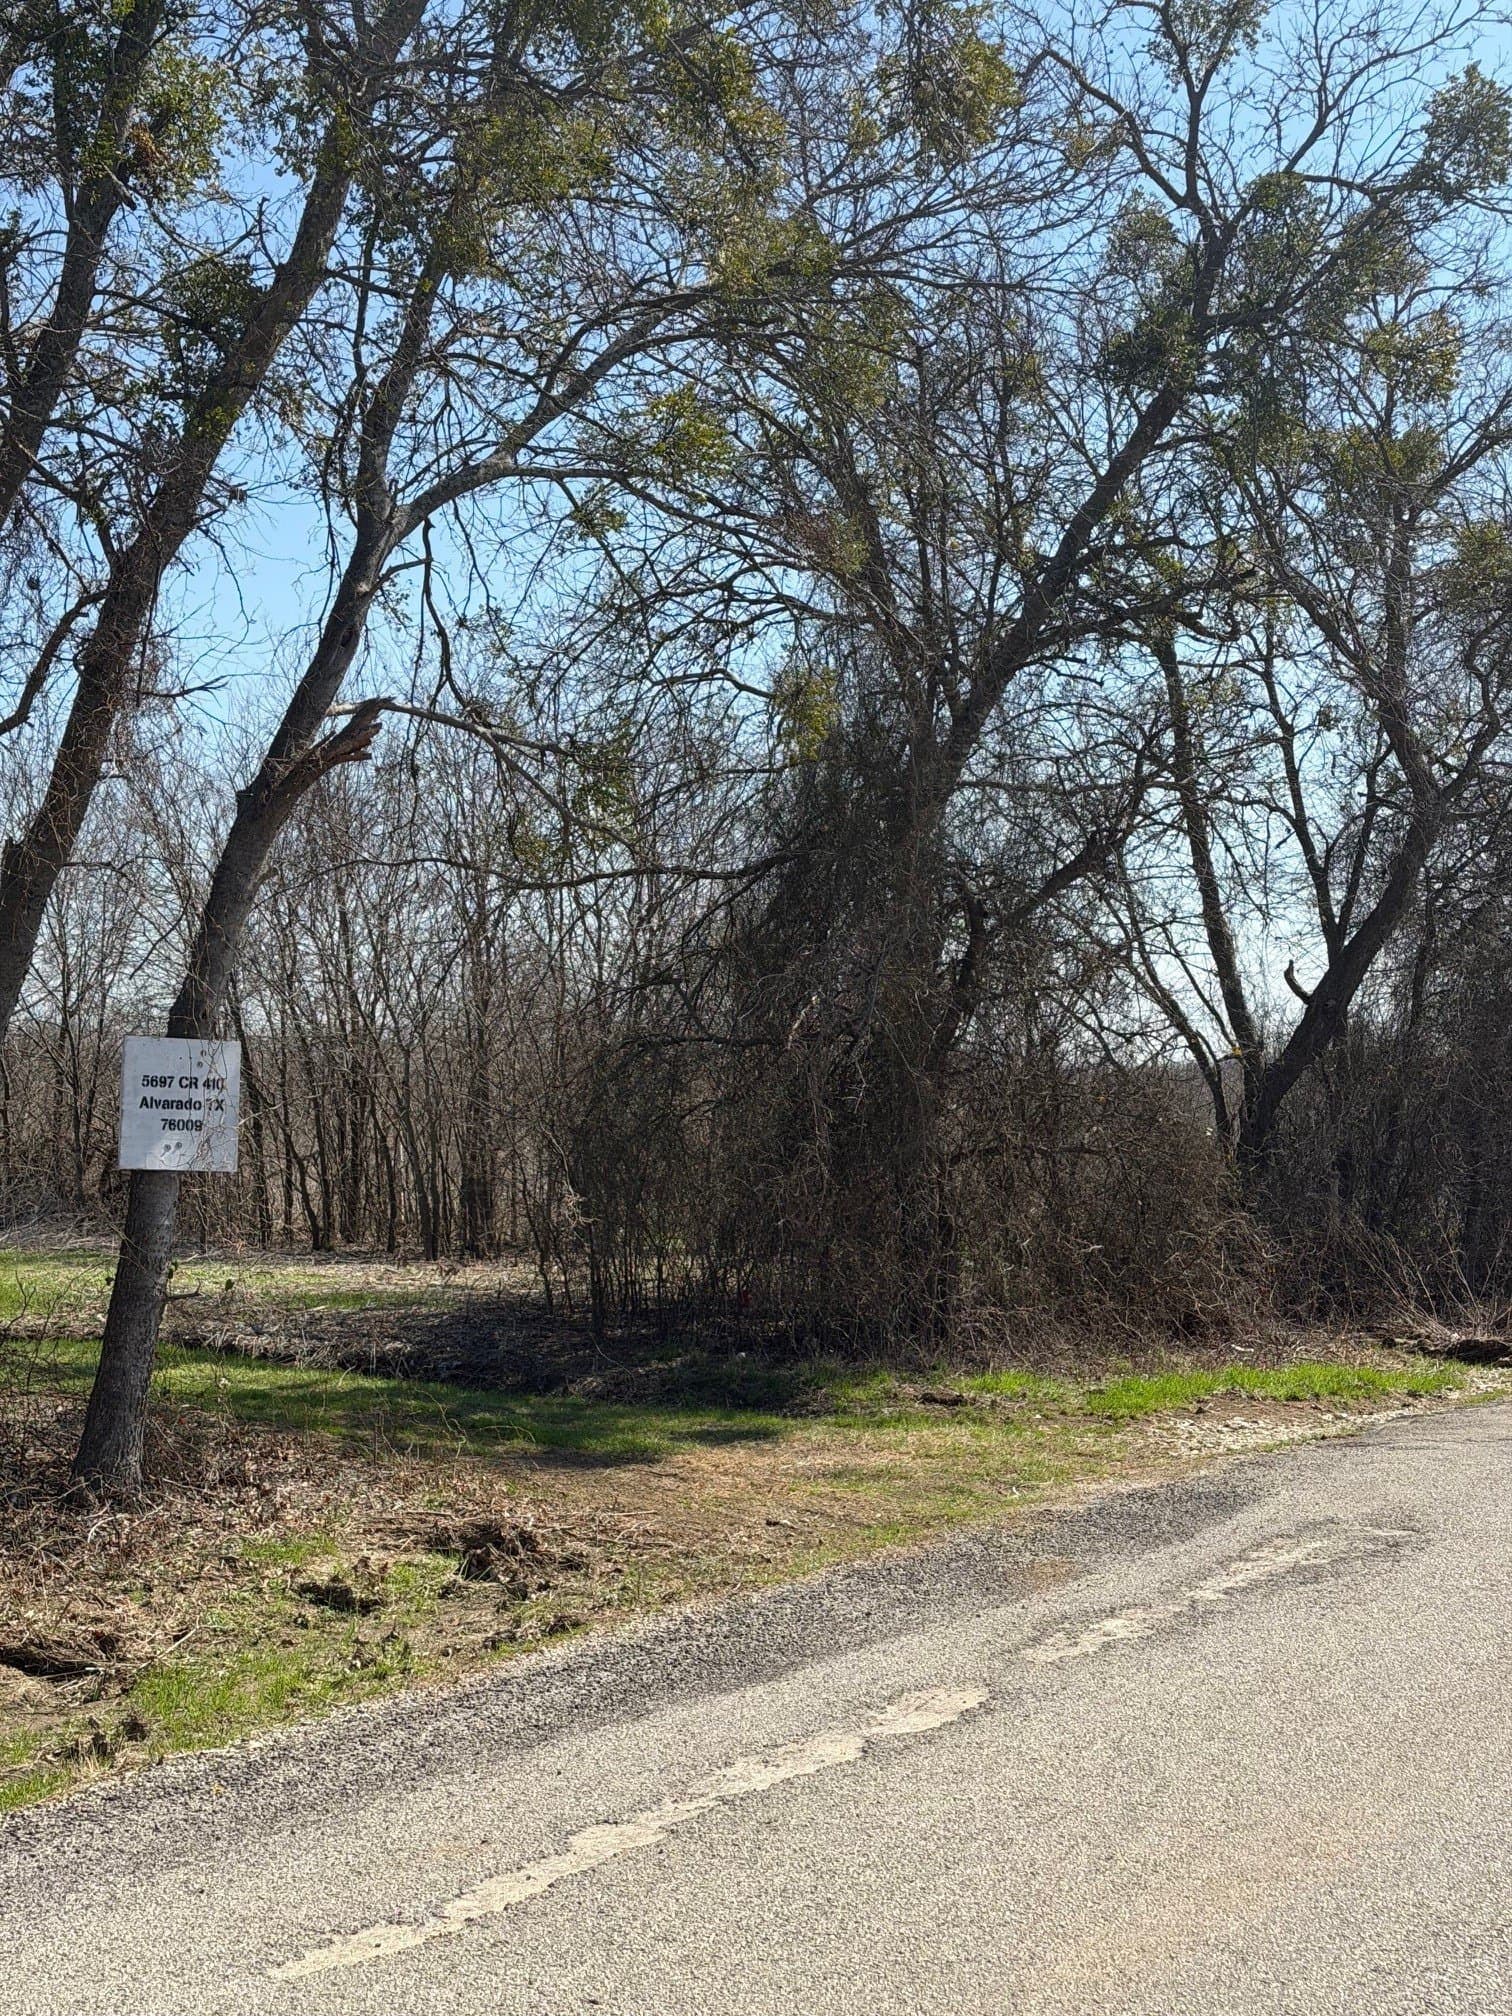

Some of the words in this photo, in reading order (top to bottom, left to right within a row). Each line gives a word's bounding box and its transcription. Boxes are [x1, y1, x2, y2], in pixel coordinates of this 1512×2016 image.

[141, 1075, 175, 1089] 5697
[178, 1076, 199, 1089] CR
[202, 1077, 225, 1090] 410
[139, 1096, 202, 1111] Alvarado
[160, 1118, 204, 1131] 76009
